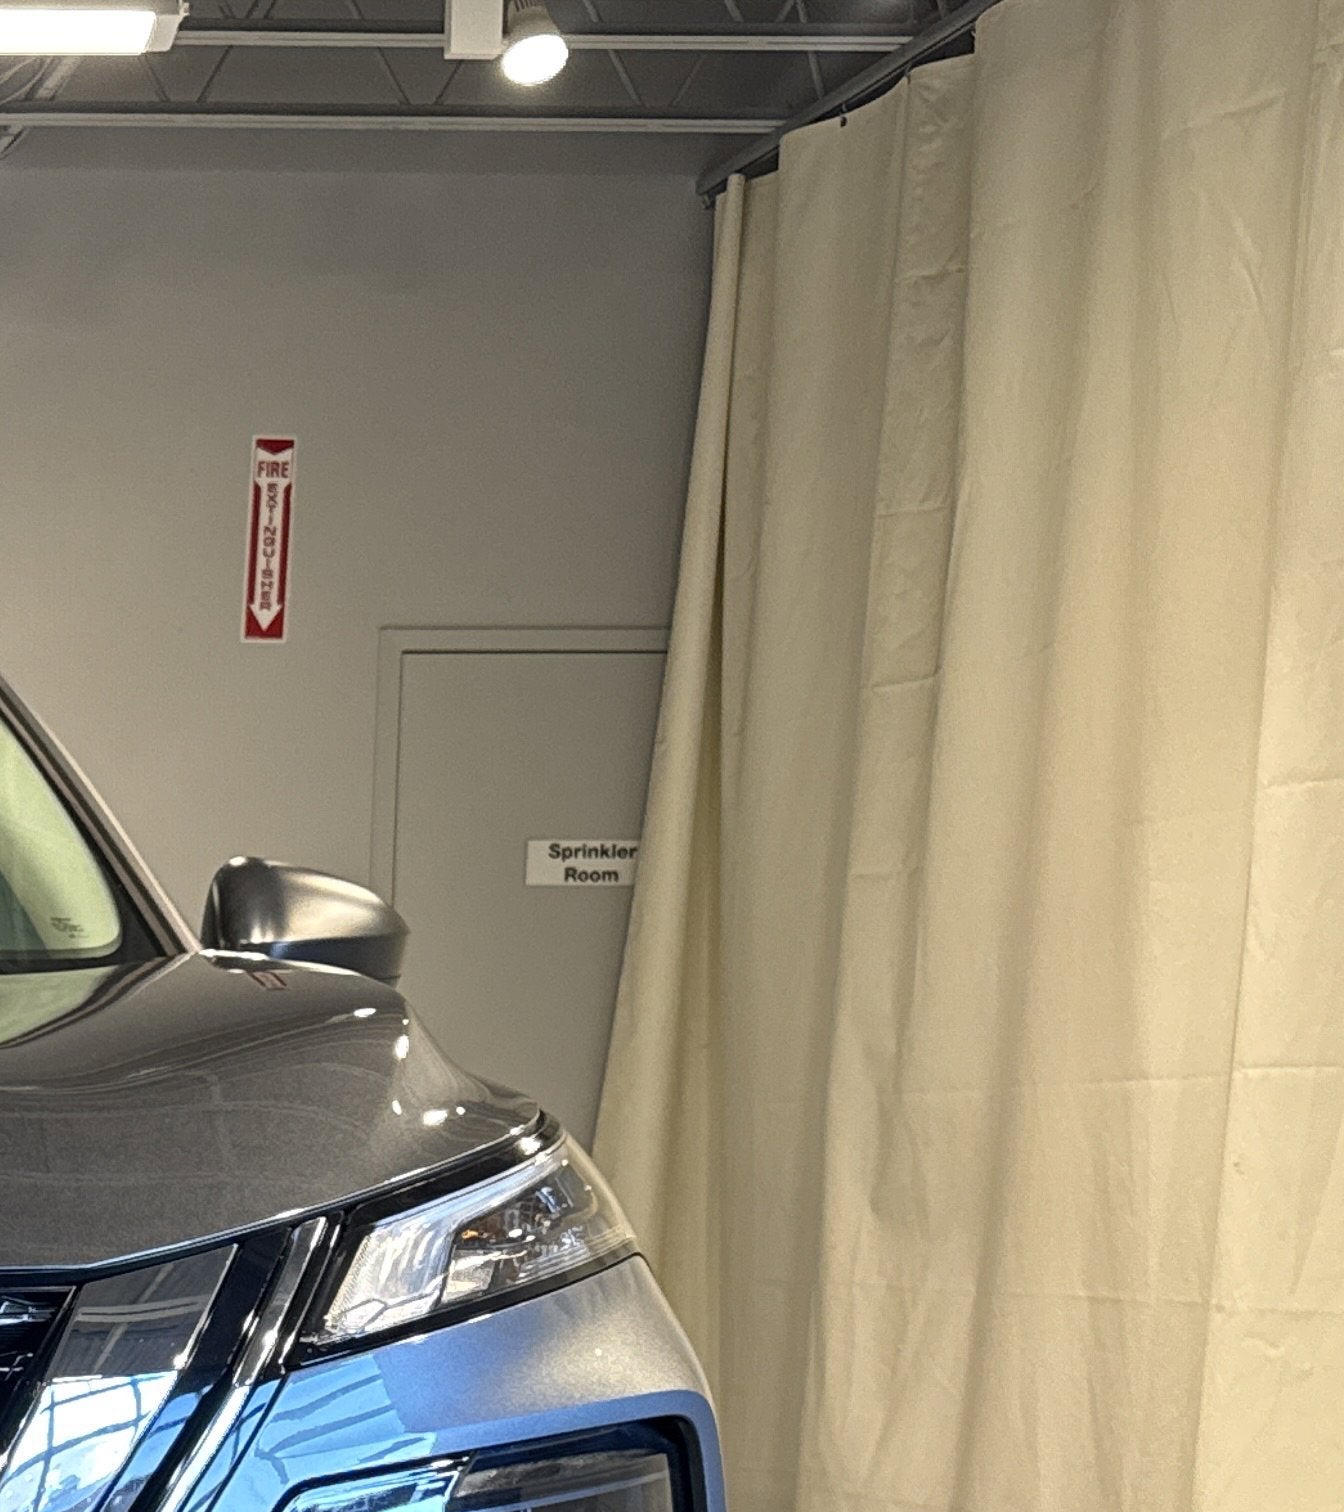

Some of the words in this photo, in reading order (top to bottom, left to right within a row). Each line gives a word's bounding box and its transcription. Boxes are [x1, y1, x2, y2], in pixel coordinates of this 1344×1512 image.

[257, 461, 289, 478] FIRE
[259, 483, 279, 611] EXTINGUISHER
[548, 843, 638, 862] Sprinkler
[564, 866, 619, 882] Room
